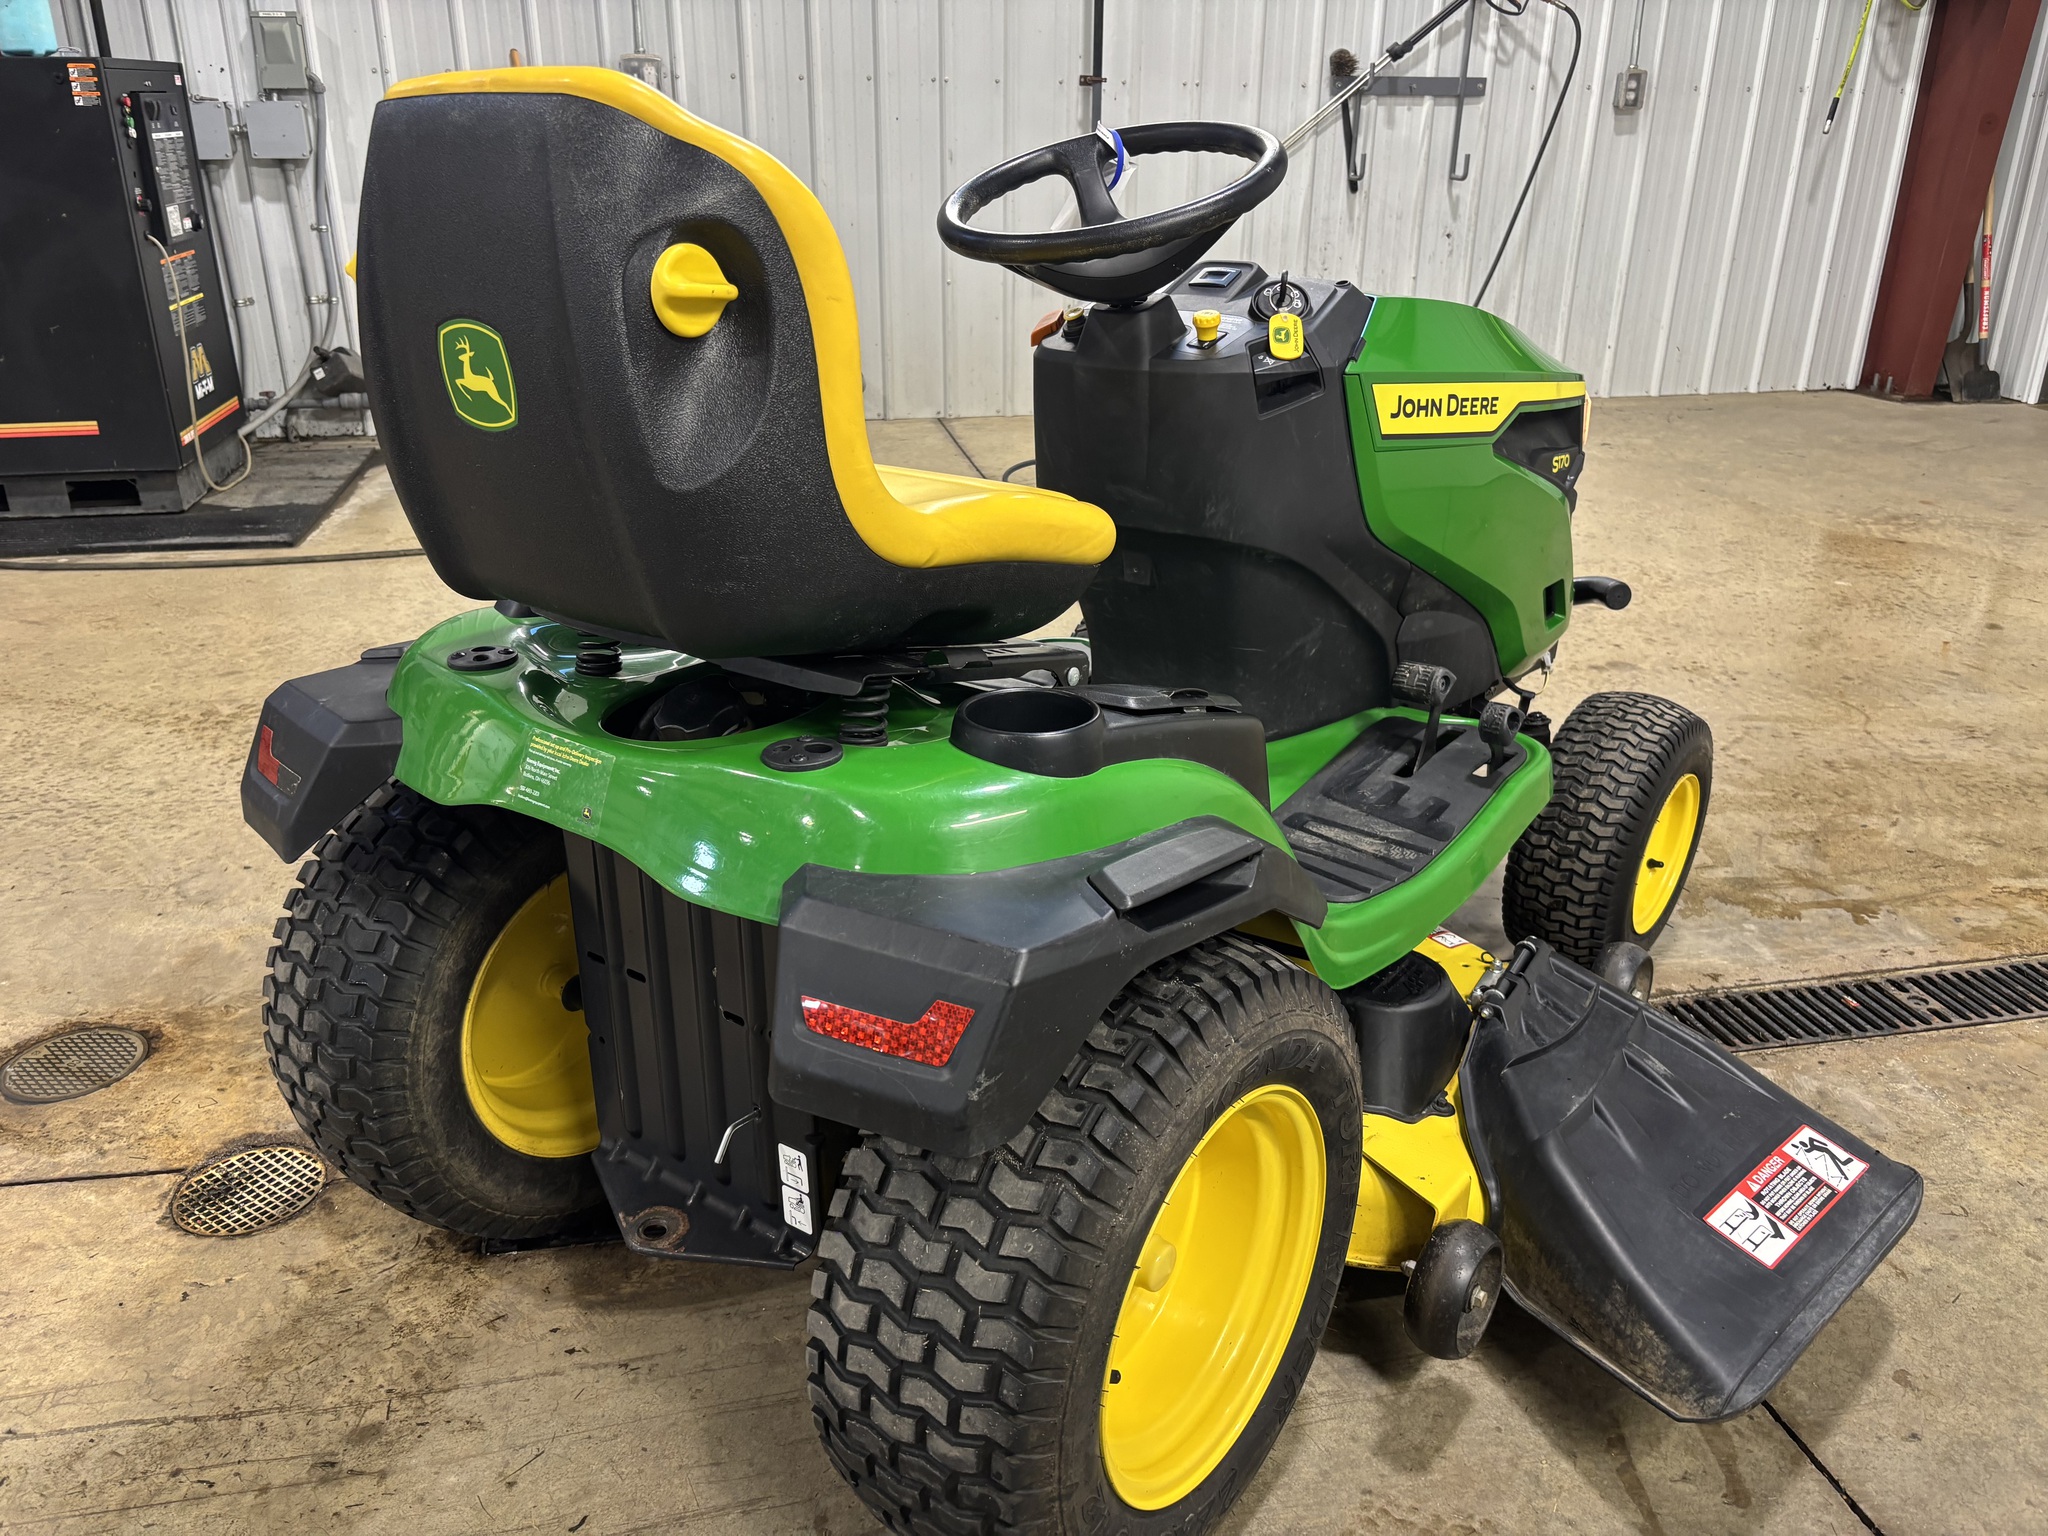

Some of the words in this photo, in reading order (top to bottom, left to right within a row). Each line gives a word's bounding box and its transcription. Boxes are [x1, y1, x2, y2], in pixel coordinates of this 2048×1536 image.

[1982, 290, 1990, 330] CRAFTSMAN
[1390, 395, 1442, 419] JOHN
[1446, 394, 1499, 416] DEERE
[1552, 453, 1570, 473] S170
[1202, 1037, 1324, 1137] KENDA
[1331, 1077, 1361, 1209] TURF
[1751, 1154, 1785, 1184] DANGER
[1273, 1231, 1350, 1425] RIDER
